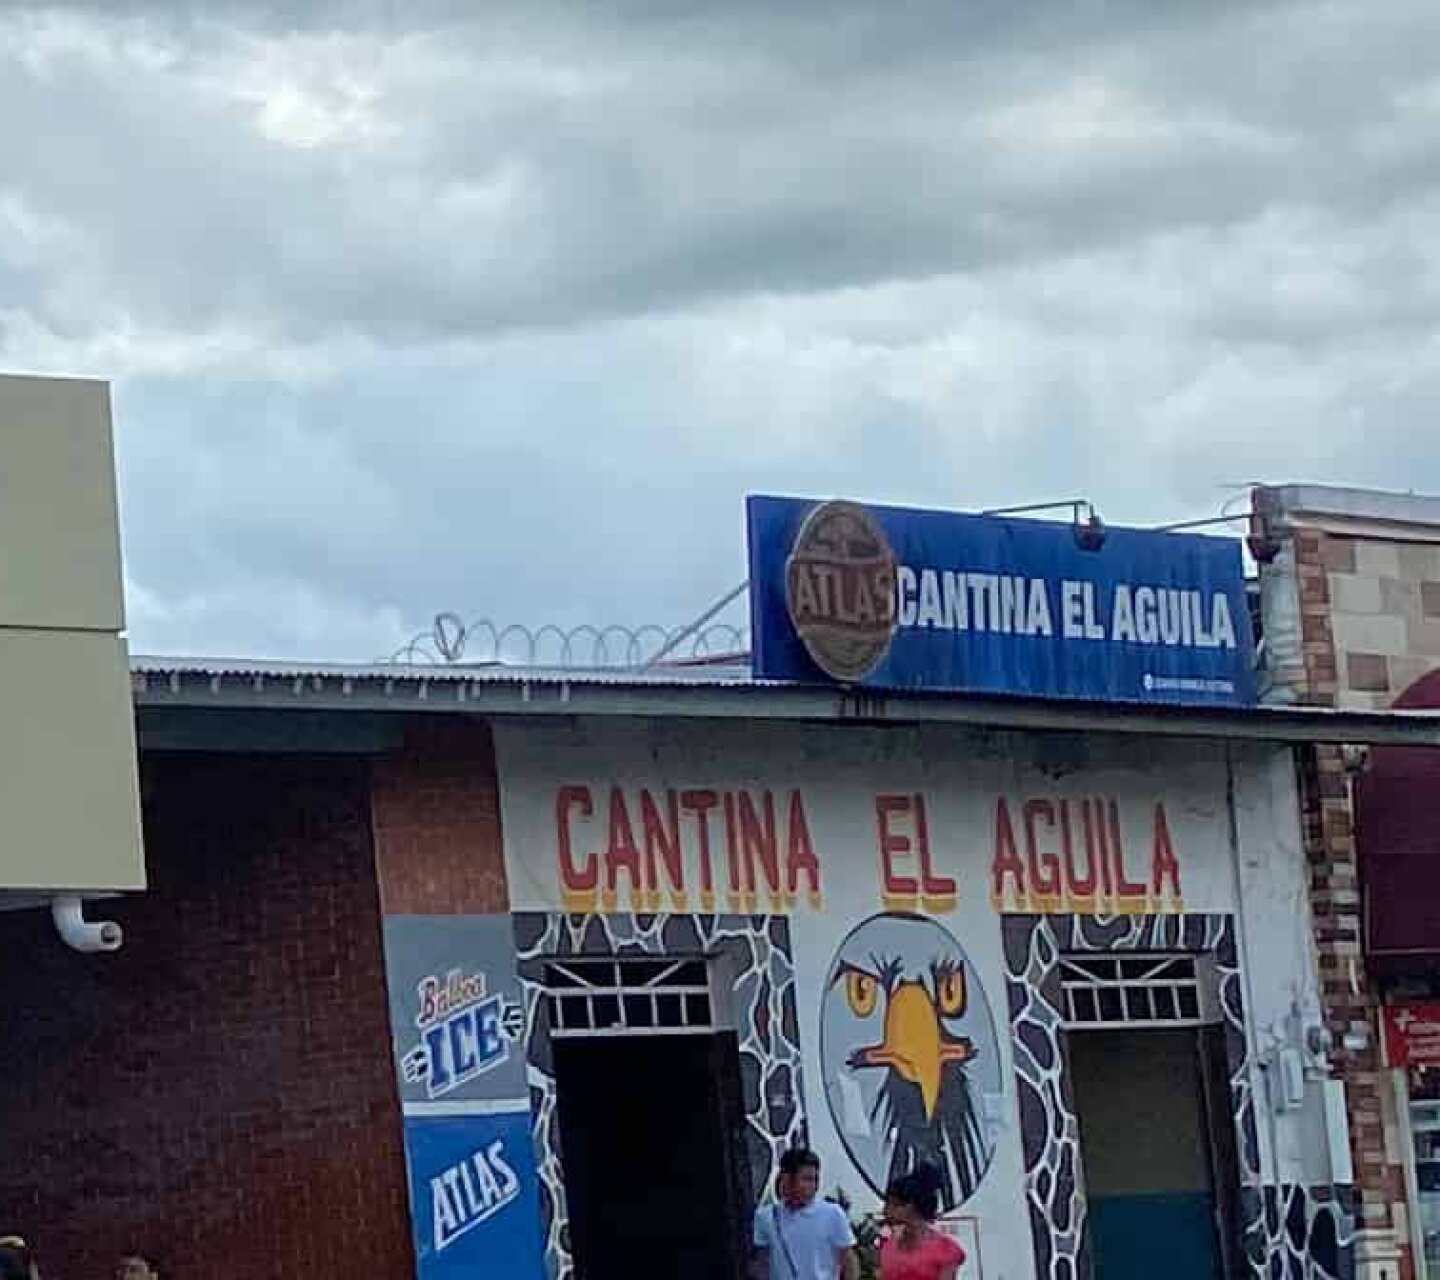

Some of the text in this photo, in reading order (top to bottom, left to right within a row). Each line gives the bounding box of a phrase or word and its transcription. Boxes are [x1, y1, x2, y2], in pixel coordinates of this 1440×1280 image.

[797, 562, 895, 625] ATLAS
[897, 564, 1236, 650] CANTINA EL AGUILA
[555, 783, 1184, 916] CANTINA EL AGUILA
[423, 995, 509, 1094] ICE
[431, 1137, 521, 1238] ATLAS
